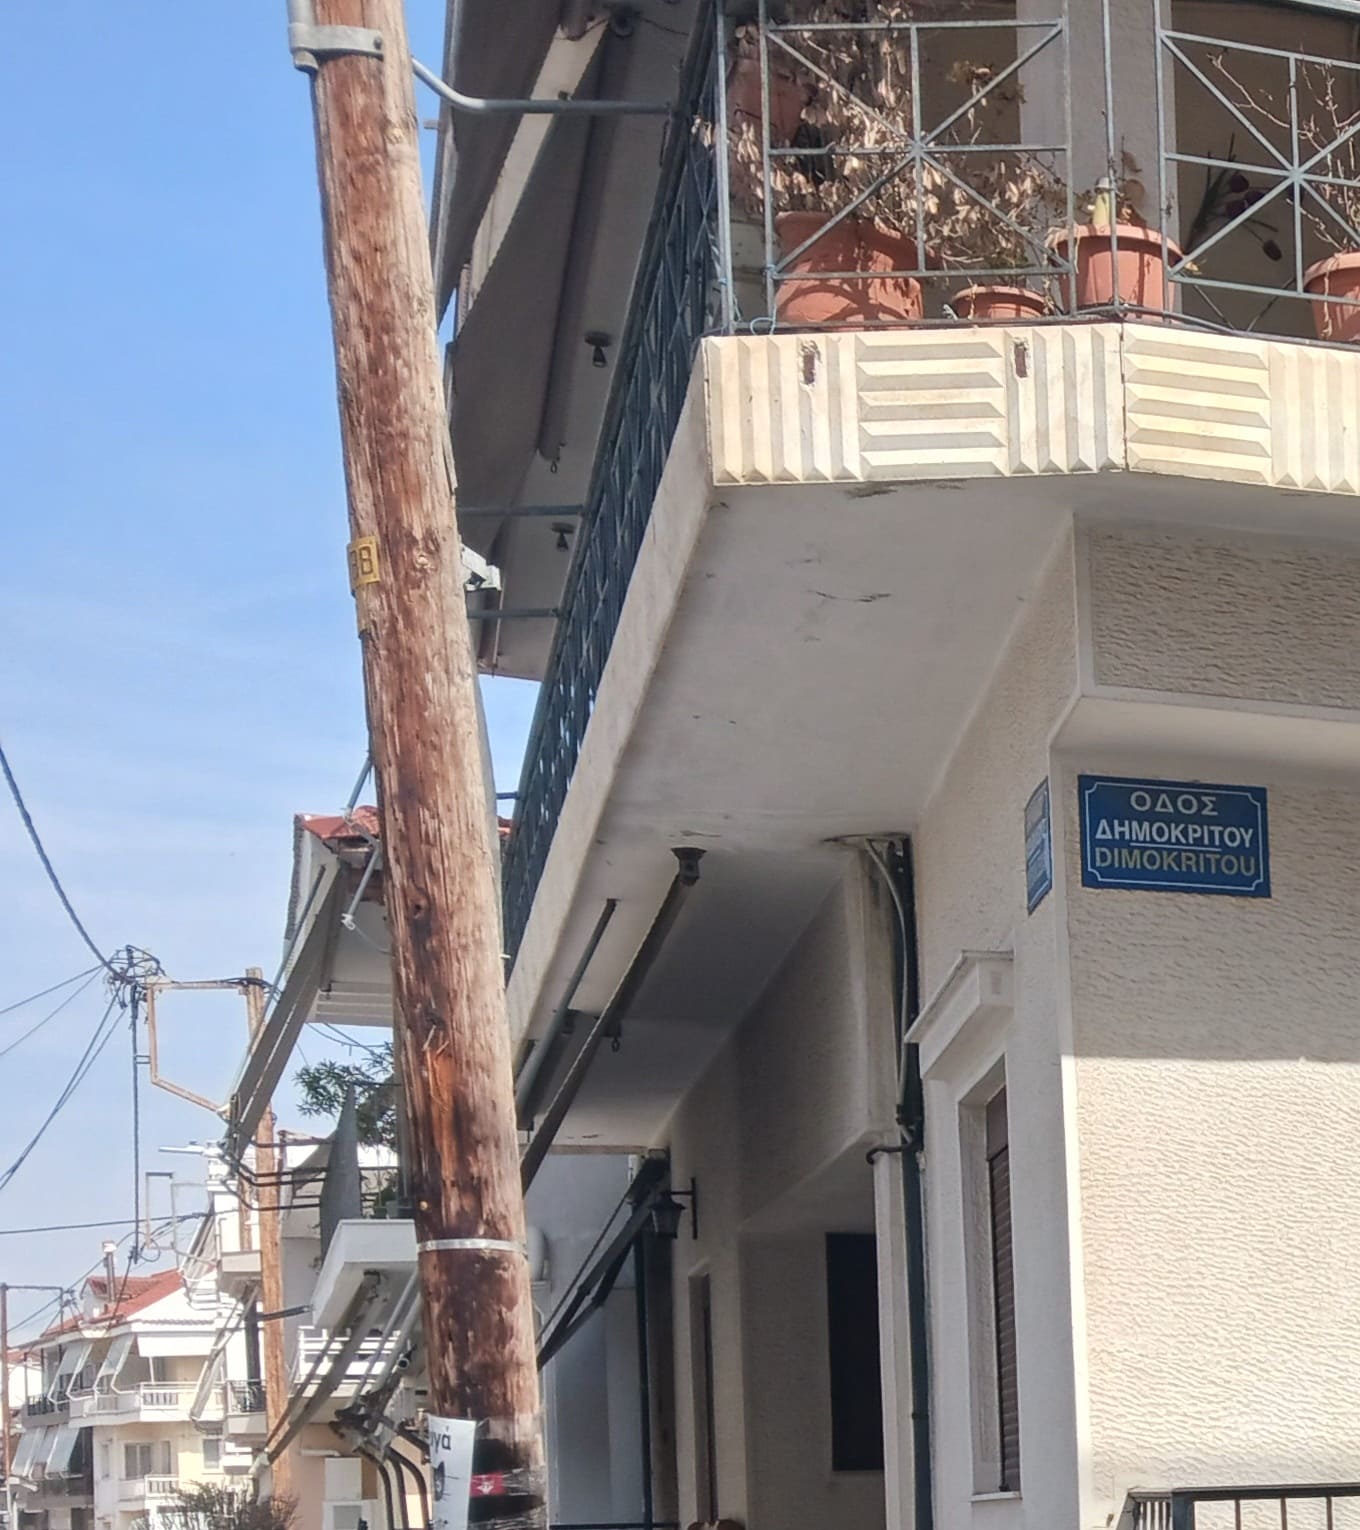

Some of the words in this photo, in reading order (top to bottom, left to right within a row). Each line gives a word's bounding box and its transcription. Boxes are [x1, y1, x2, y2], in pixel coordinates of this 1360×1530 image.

[1130, 791, 1219, 816] ΟΔΟΣ
[1095, 818, 1254, 848] ΔΗΜΟΚΡΙΤΟΥ
[1095, 846, 1256, 876] DIMOKRITOU
